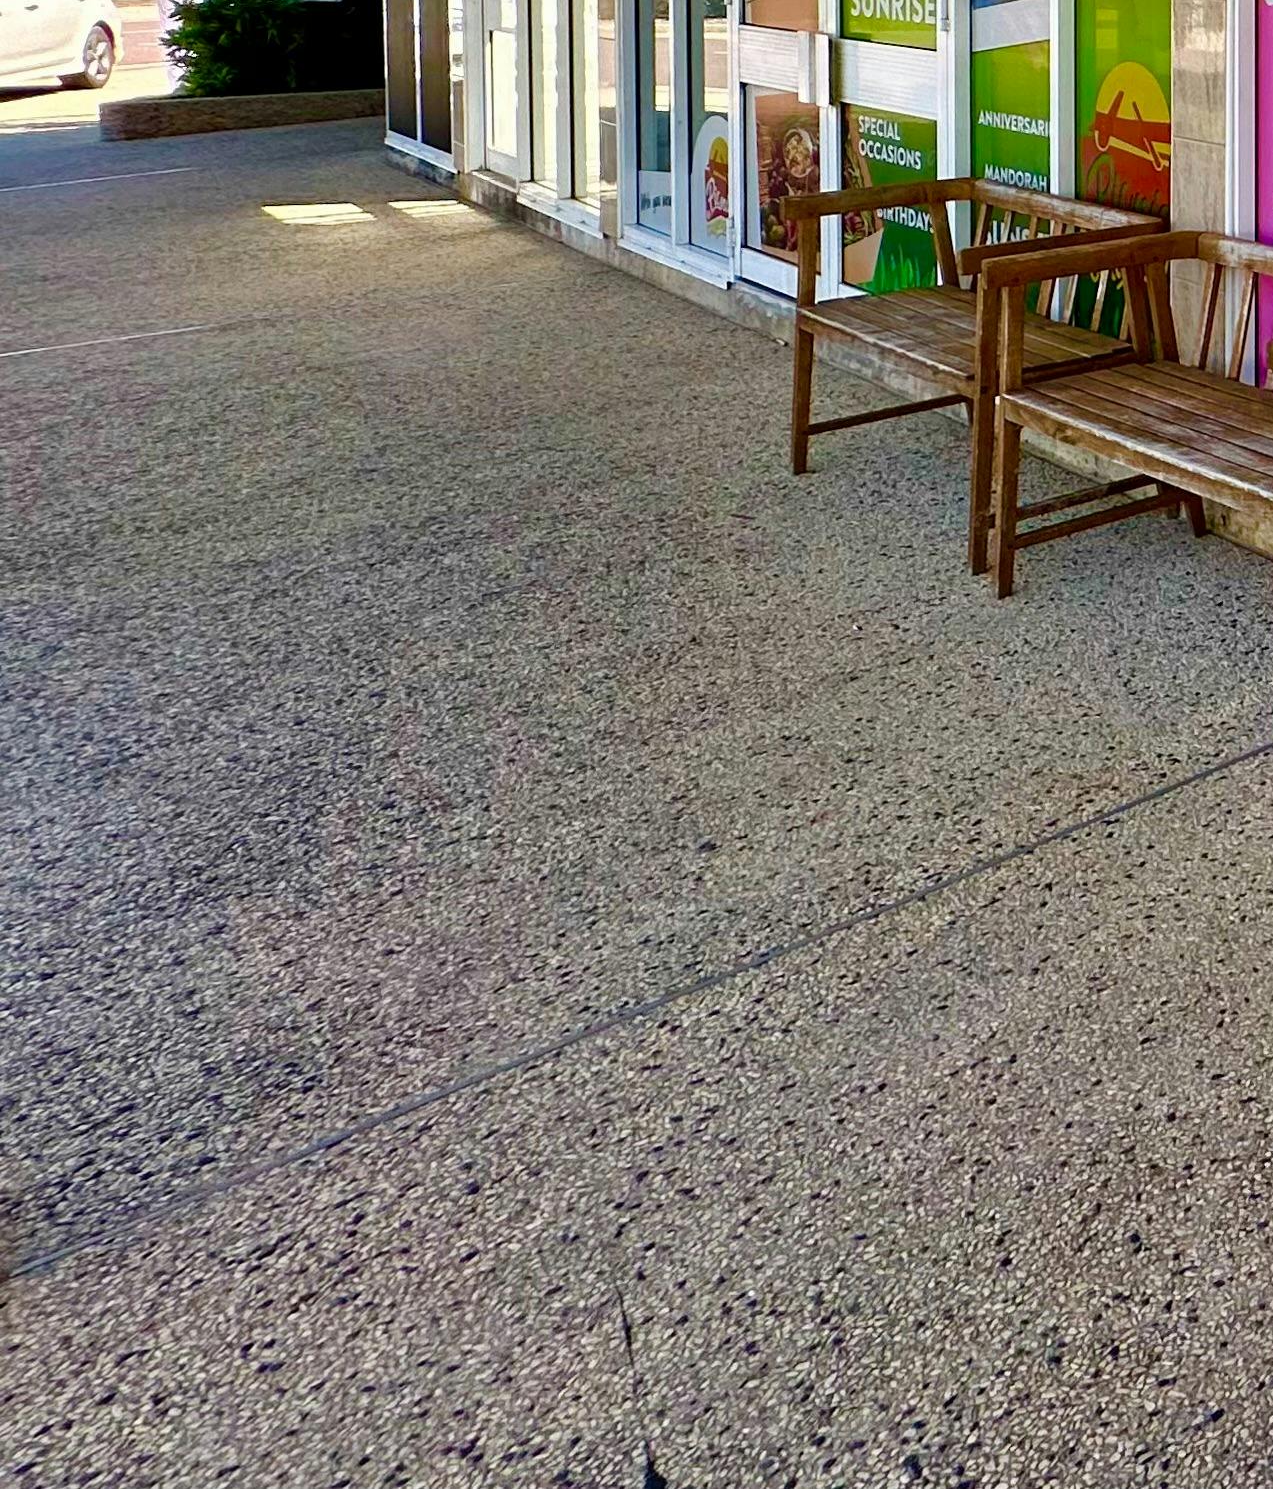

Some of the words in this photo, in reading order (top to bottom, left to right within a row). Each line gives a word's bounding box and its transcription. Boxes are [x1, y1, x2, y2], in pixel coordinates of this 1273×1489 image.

[858, 115, 901, 141] SPECIAL
[858, 139, 921, 170] OCCASIONS
[984, 163, 1047, 192] MANDORAH
